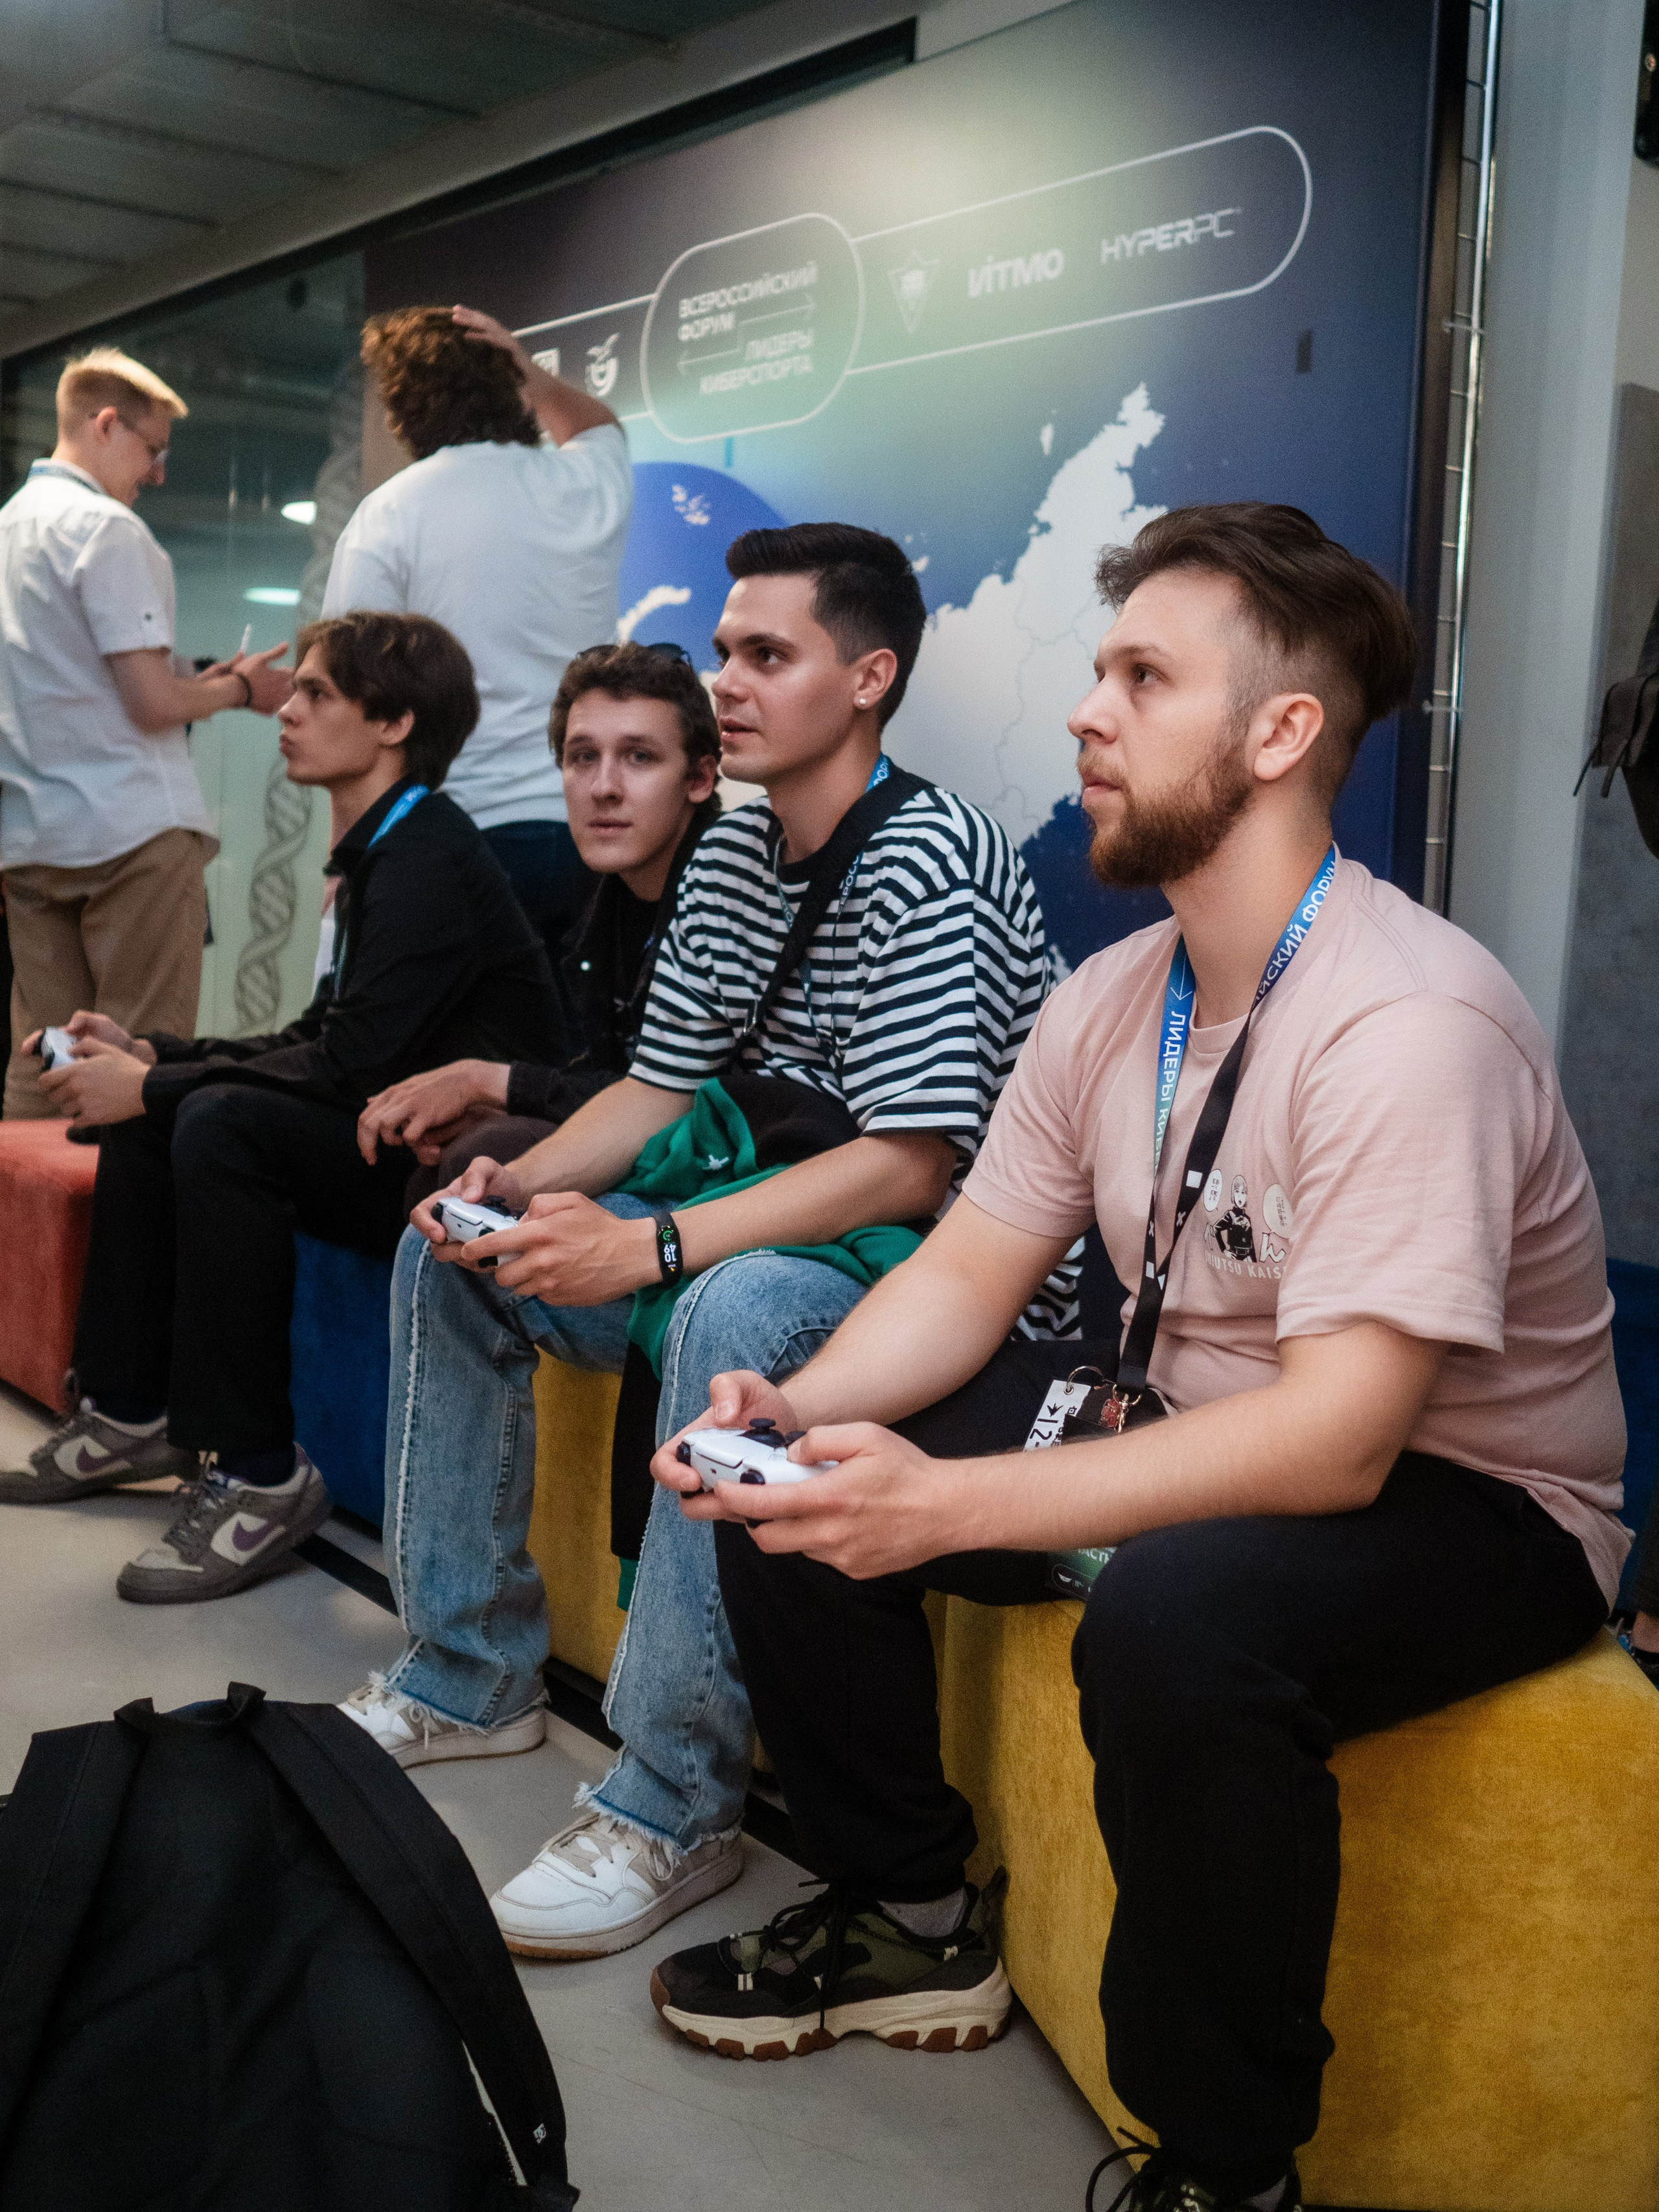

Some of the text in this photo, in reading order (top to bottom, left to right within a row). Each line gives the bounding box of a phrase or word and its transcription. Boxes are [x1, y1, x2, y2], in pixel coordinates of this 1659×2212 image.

[1101, 207, 1236, 263] HYPERPC
[679, 261, 818, 318] ВСЕРОССИЙСКИЙ
[678, 310, 736, 342] ФОРУМ
[745, 329, 814, 360] ЛИДЕРЫ
[699, 355, 813, 395] КИБЕРСПОРТА
[1161, 1010, 1186, 1101] ЛИДЕРЫ
[1247, 1264, 1286, 1280] KAIS
